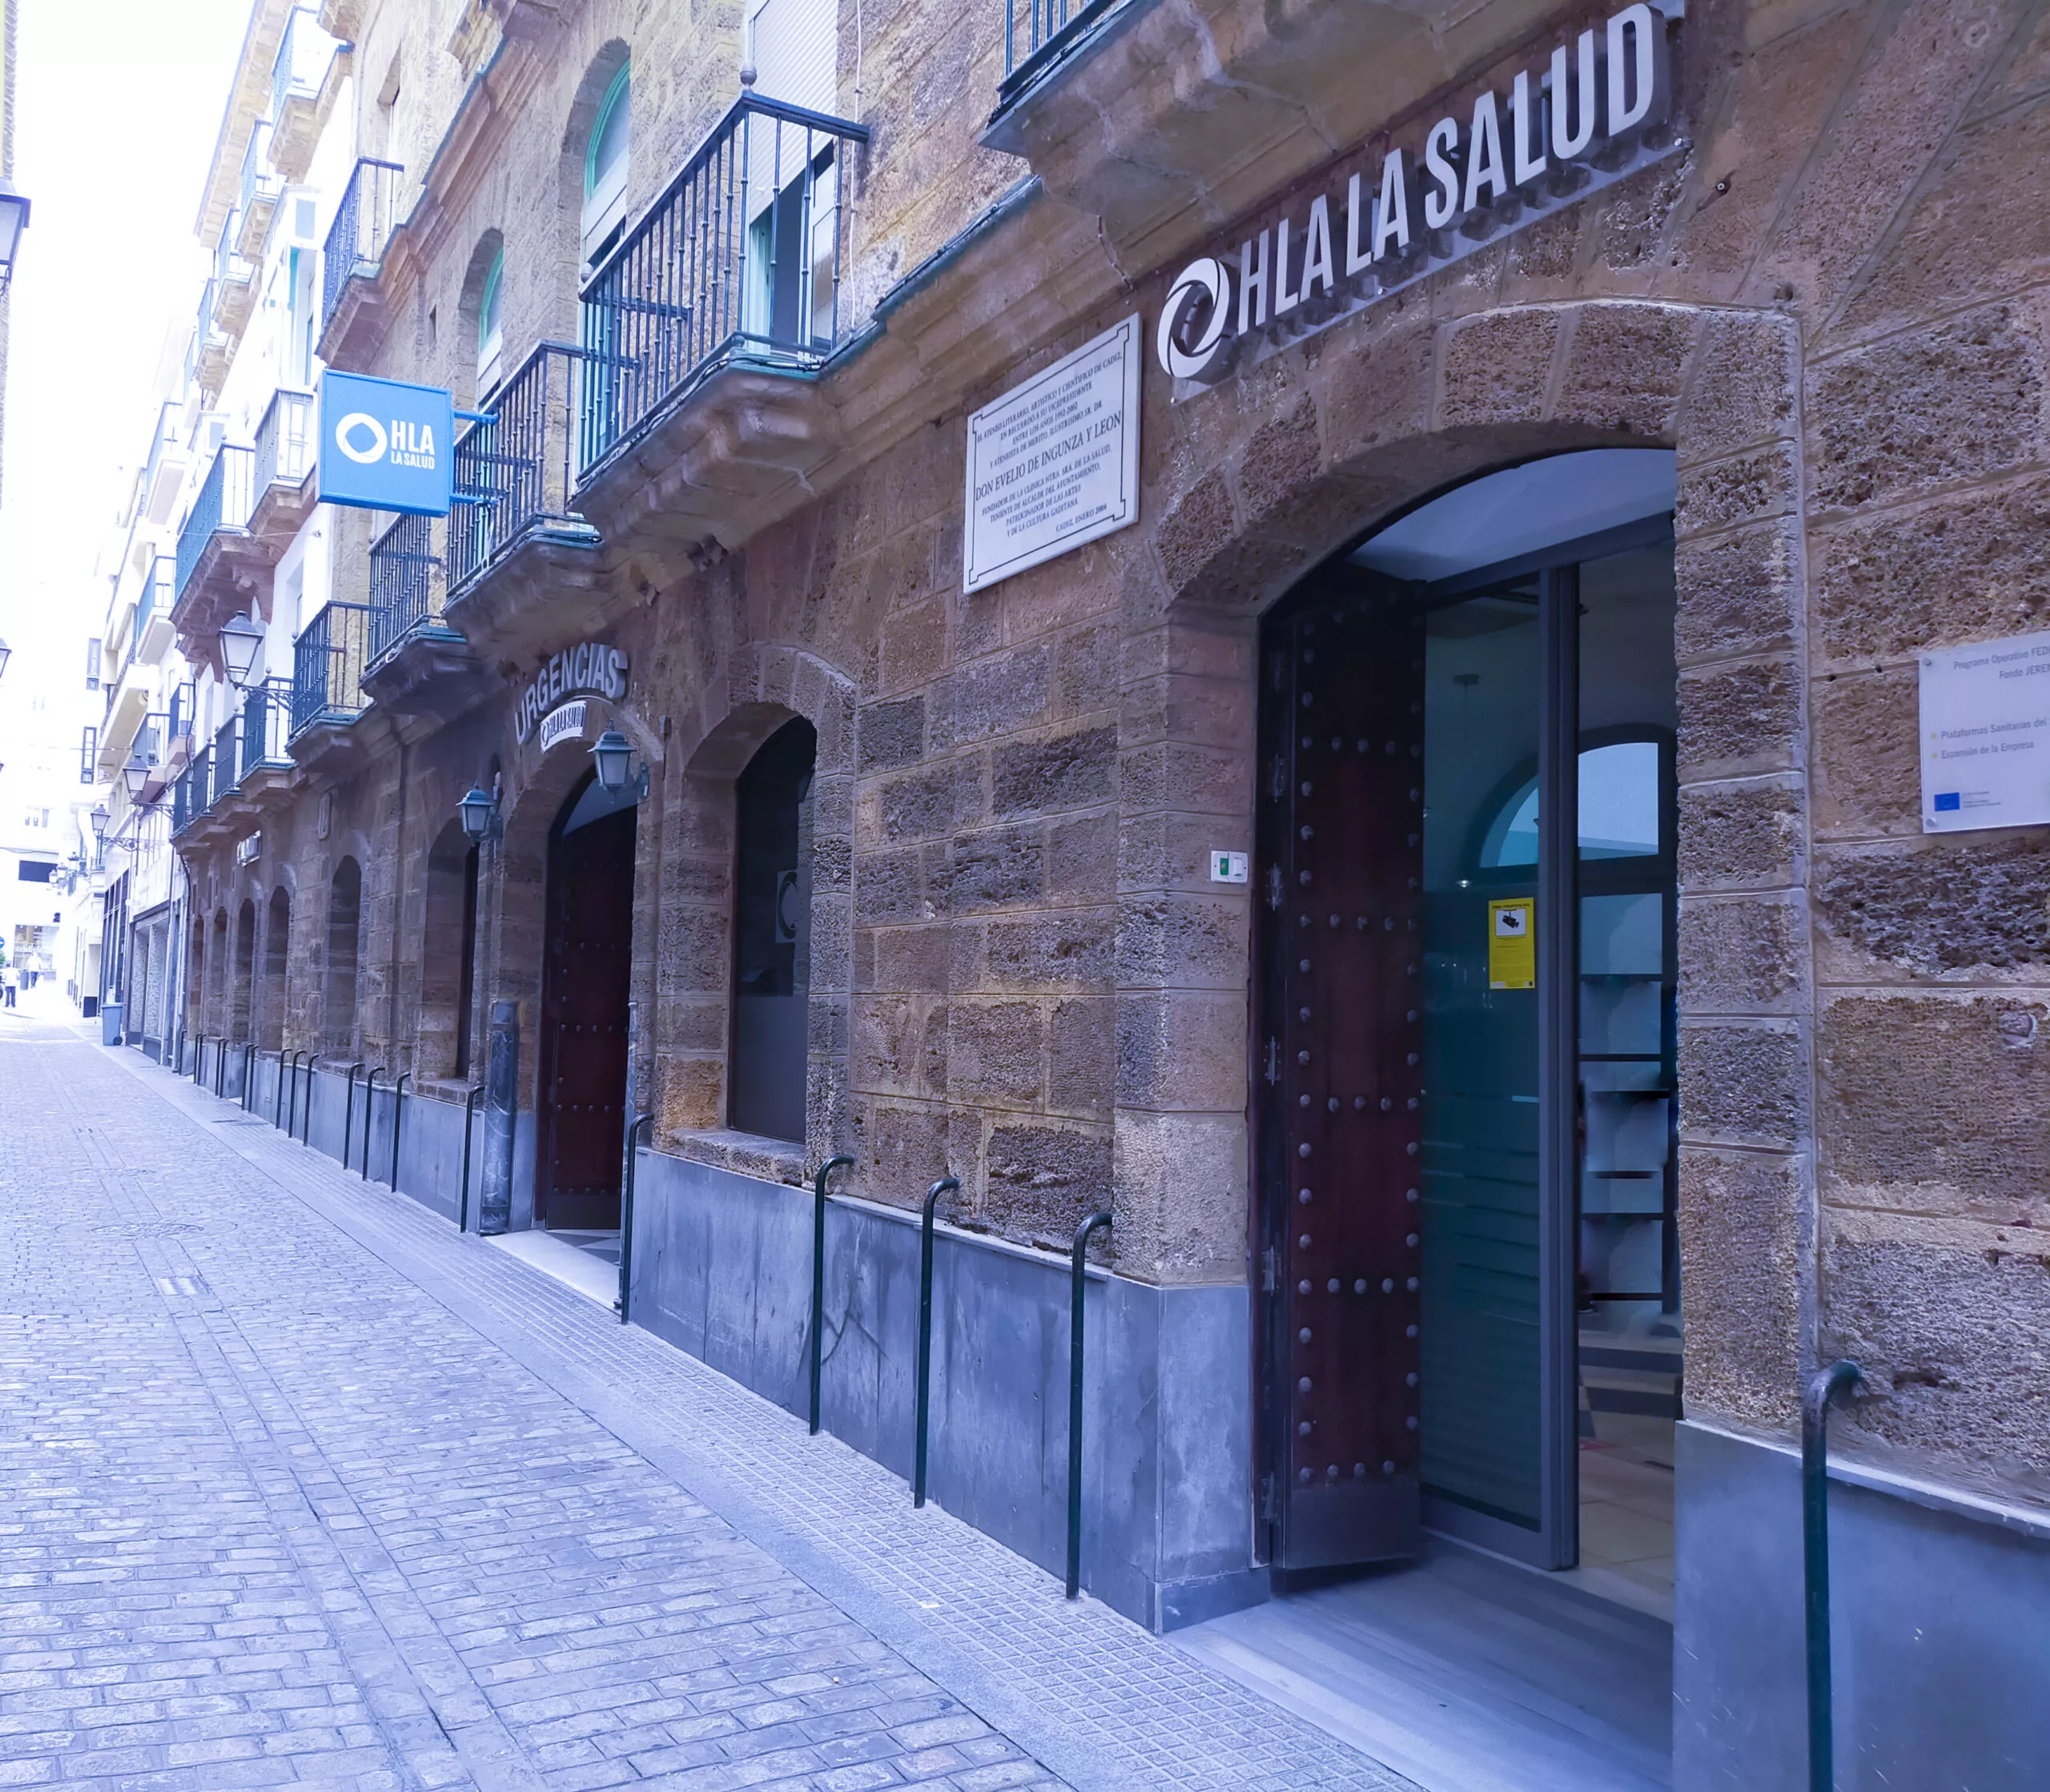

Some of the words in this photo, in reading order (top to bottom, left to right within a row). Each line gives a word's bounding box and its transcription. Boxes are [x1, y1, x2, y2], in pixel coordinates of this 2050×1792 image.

[1236, 194, 1335, 336] HLA
[1346, 147, 1410, 277] LA
[1425, 2, 1665, 230] SALUD
[983, 421, 1002, 439] ATENEO
[1094, 362, 1101, 375] DE
[1000, 429, 1007, 440] EN
[1008, 412, 1035, 436] RECUERDO
[1035, 410, 1039, 420] A
[1040, 406, 1046, 418] SU
[1048, 380, 1091, 413] VICEPRESIDENTE
[391, 420, 435, 456] HLA
[1012, 428, 1027, 445] ENTRE
[1029, 422, 1039, 436] LOS
[1019, 441, 1027, 452] DE
[391, 451, 403, 464] LA
[404, 452, 435, 469] SALUD
[975, 478, 993, 501] DON
[995, 460, 1025, 491] EVELIO
[1027, 453, 1039, 474] DE
[1041, 429, 1083, 467] INGUNZA
[1086, 425, 1091, 444] Y
[1094, 409, 1120, 439] LEON
[982, 495, 1007, 516] FUNDADOR
[1009, 491, 1015, 502] DE
[1017, 488, 1023, 498] LA
[1074, 457, 1081, 469] DE
[1083, 453, 1090, 465] LA
[990, 504, 1012, 523] TENIENTE
[1014, 500, 1020, 511] DE
[1022, 489, 1043, 507] ALCALDE
[1045, 484, 1054, 496] DEL
[1006, 500, 1043, 527] PATROCINADOR
[1045, 496, 1051, 508] DE
[1053, 491, 1063, 504] LAS
[1064, 483, 1080, 499] ARTES
[1011, 524, 1018, 536] DE
[1019, 521, 1024, 532] LA
[1026, 510, 1049, 528] CULTURA
[1051, 496, 1078, 517] GADITANA
[1075, 508, 1094, 524] ENERO
[1954, 658, 1989, 670] Programa
[1992, 652, 2029, 665] Operativo
[2032, 645, 2050, 657] FED
[1999, 669, 2024, 679] Fondo
[514, 642, 628, 745] URGENCIAS
[1941, 728, 1988, 739] Plataformas
[1991, 721, 2032, 733] Sanitarias
[2034, 717, 2047, 727] del
[1980, 745, 1990, 754] de
[1992, 744, 1999, 753] la
[2001, 741, 2034, 752] Empresa
